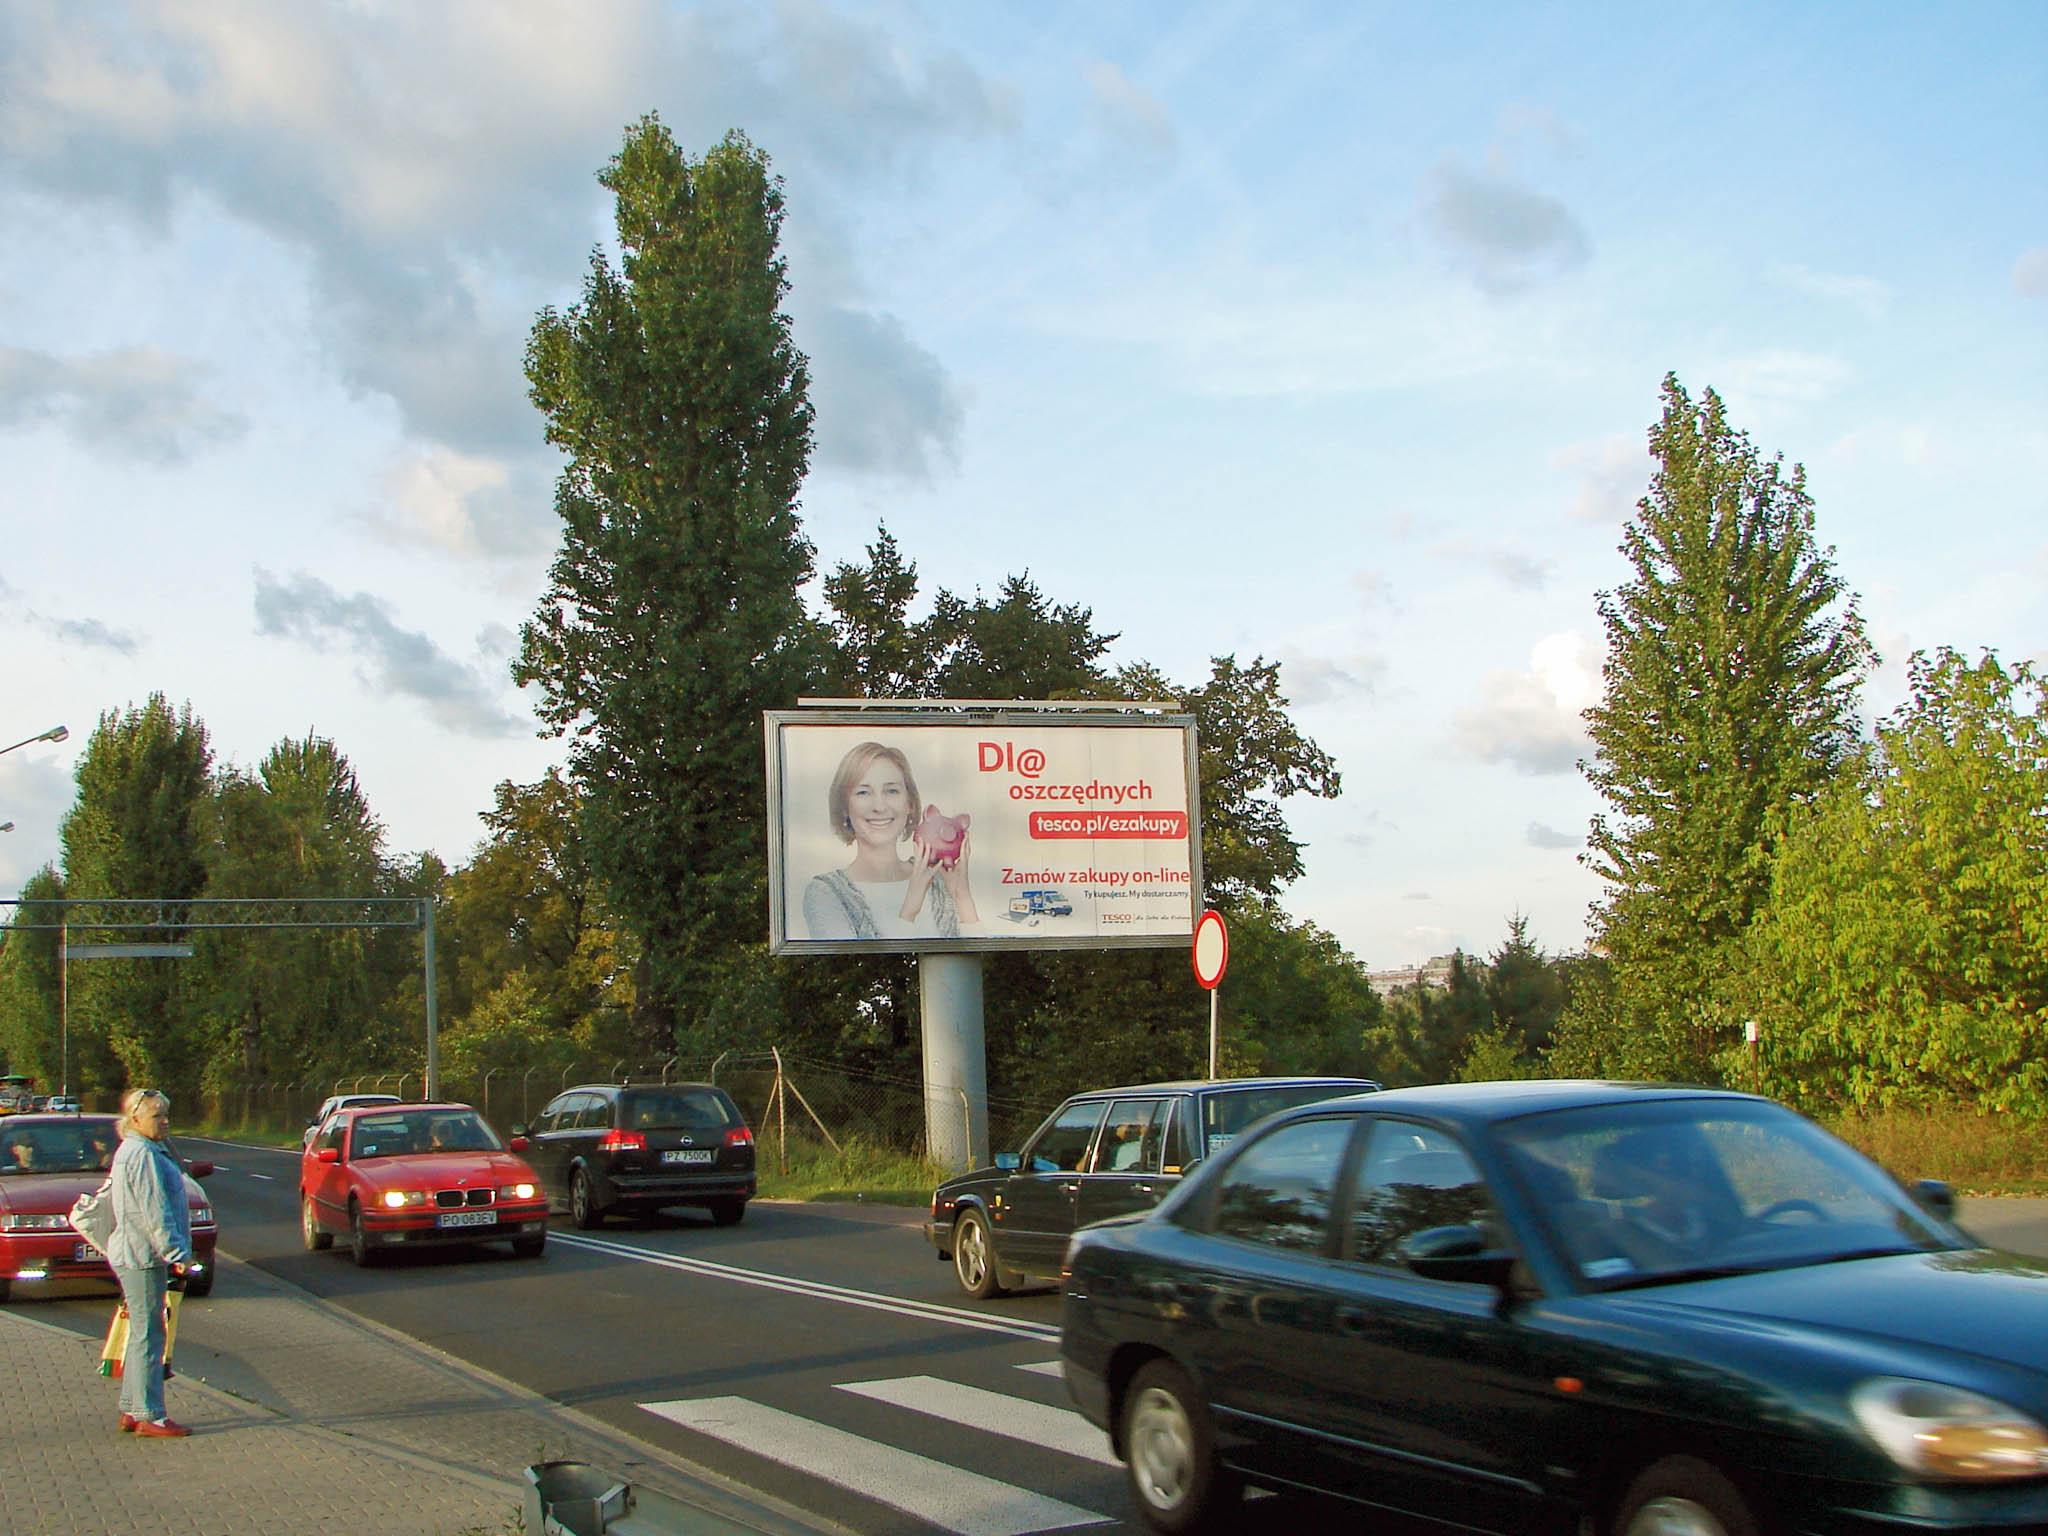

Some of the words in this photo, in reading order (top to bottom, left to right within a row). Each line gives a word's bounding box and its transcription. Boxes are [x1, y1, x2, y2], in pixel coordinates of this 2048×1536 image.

[978, 742, 1046, 778] Dl@
[1009, 779, 1153, 805] oszczędnych
[1036, 814, 1180, 835] tesco.pl/ezakupy
[1001, 868, 1065, 884] Zamów
[1069, 868, 1129, 886] zakupy
[1132, 867, 1190, 883] on-line
[1084, 890, 1092, 899] Ty
[1129, 890, 1140, 899] My
[667, 1151, 680, 1161] PZ
